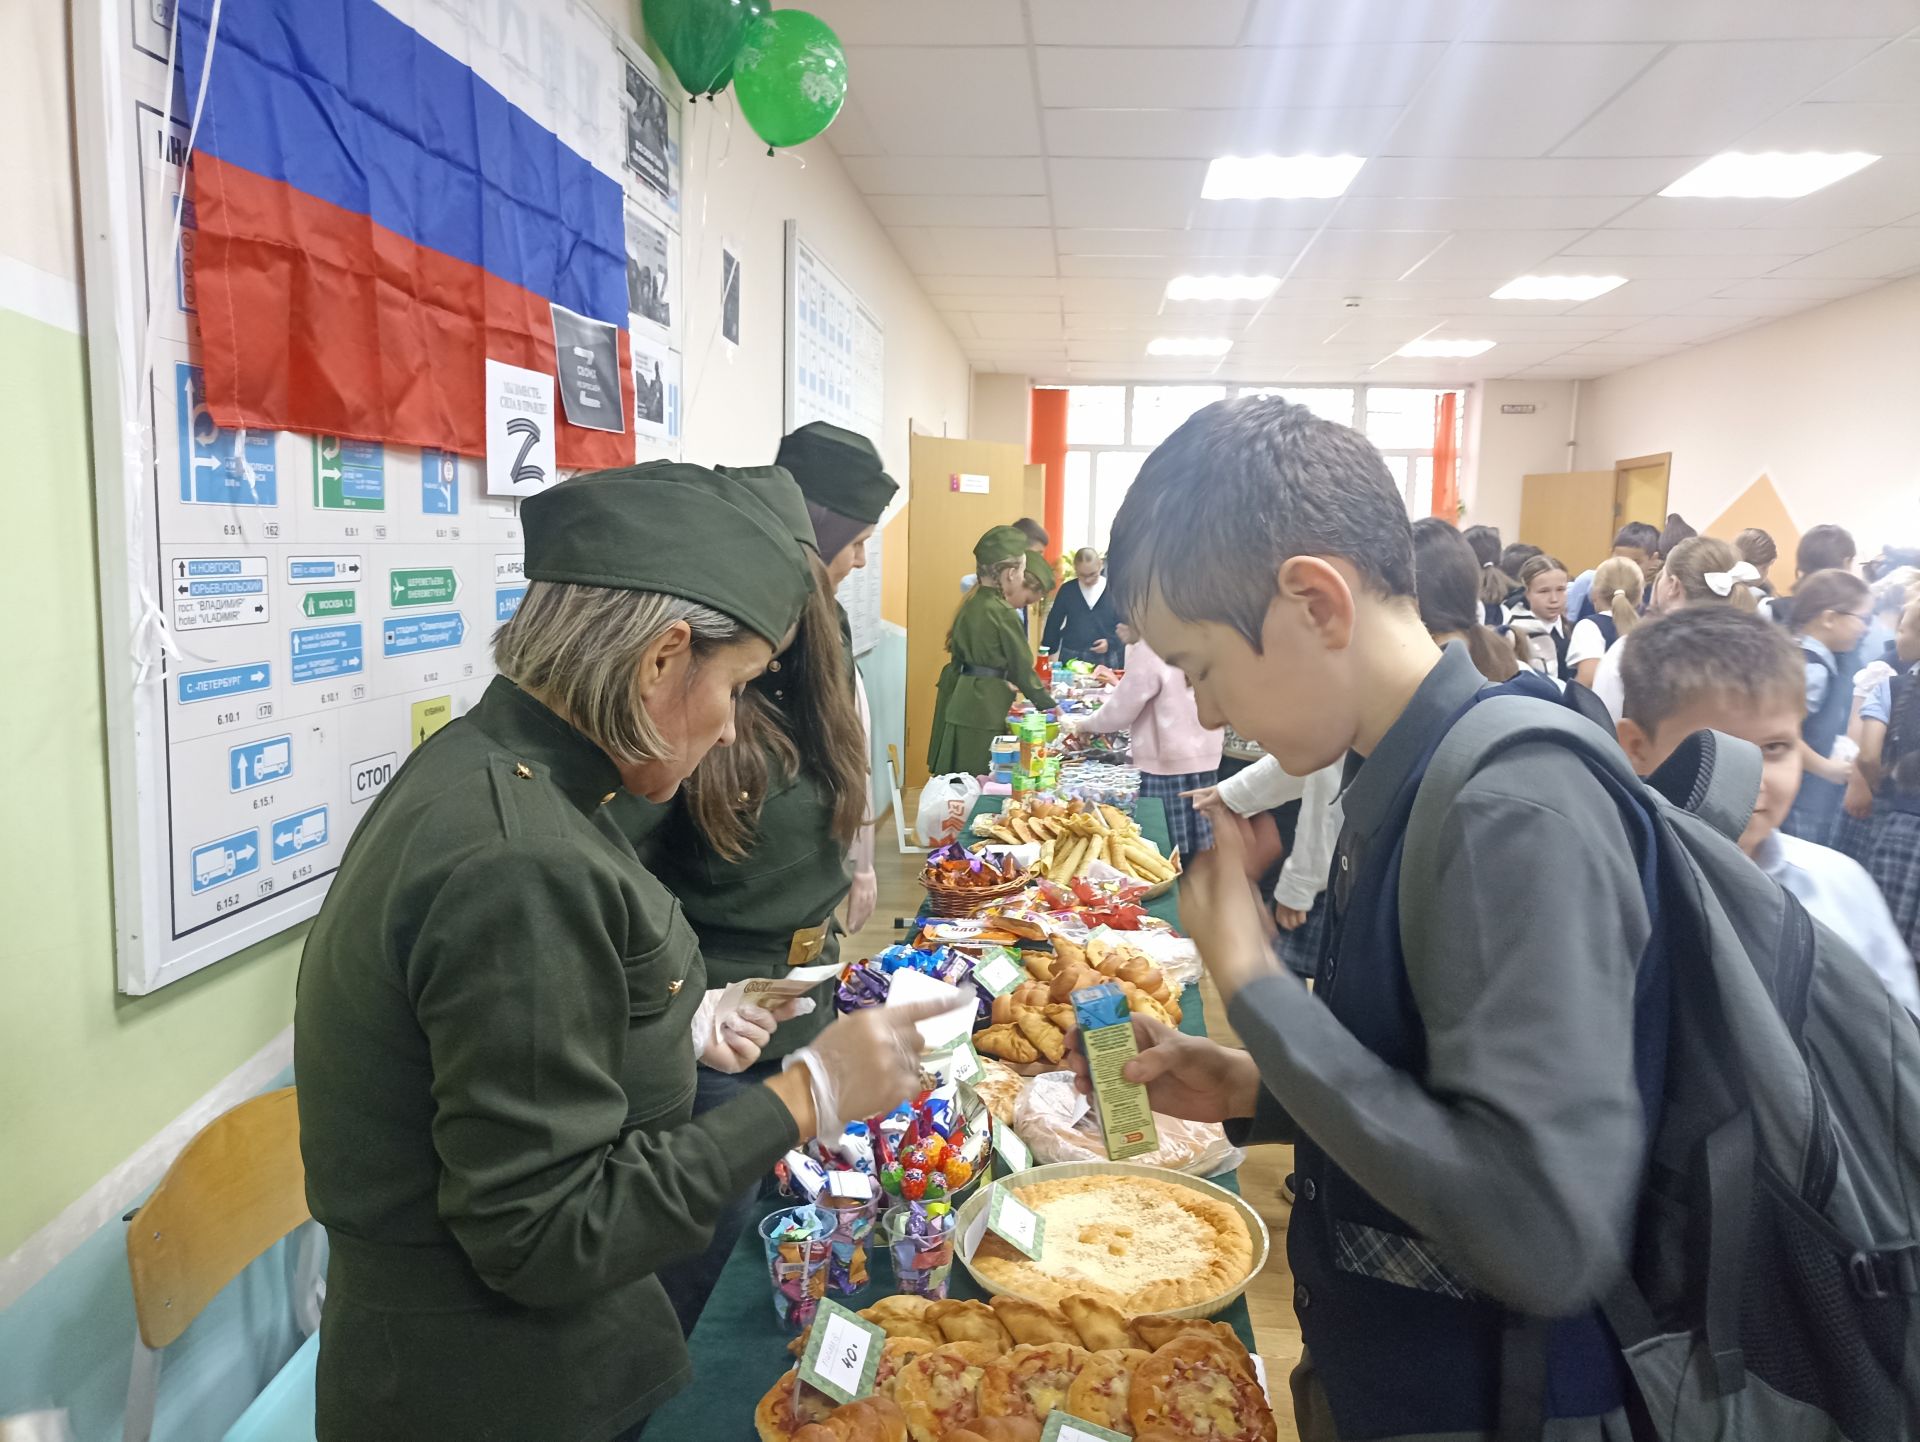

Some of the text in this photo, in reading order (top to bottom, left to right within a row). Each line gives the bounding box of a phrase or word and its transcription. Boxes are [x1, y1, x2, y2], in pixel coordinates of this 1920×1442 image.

[223, 525, 243, 536] 6.9.1
[259, 704, 272, 717] 170
[217, 711, 240, 726] 6.10.1
[356, 763, 392, 792] СТОП
[252, 795, 274, 810] 6.15.1
[292, 864, 313, 881] 6.15.3
[260, 880, 274, 894] 179
[215, 893, 240, 912] 6.15.2
